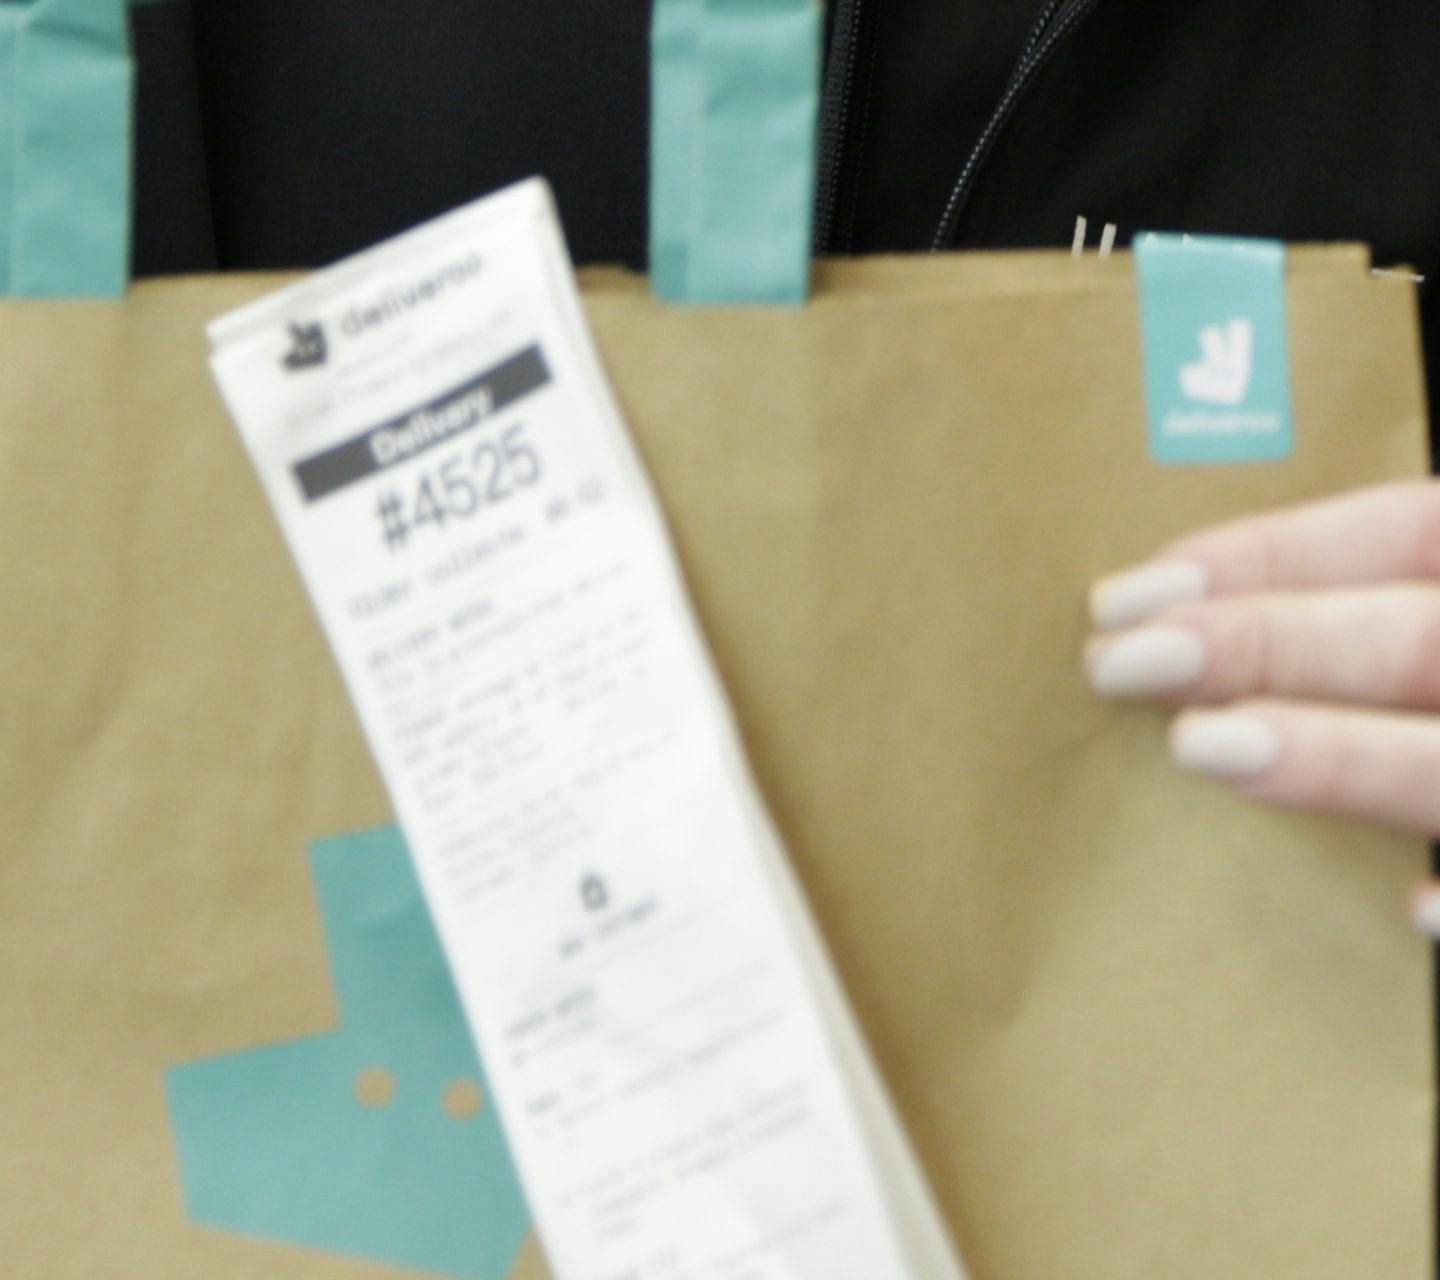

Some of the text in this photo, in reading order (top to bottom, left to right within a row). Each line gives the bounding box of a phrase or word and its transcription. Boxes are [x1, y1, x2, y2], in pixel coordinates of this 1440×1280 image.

[339, 251, 484, 339] deliveroo
[370, 384, 494, 468] Delivery
[374, 422, 543, 552] #4525
